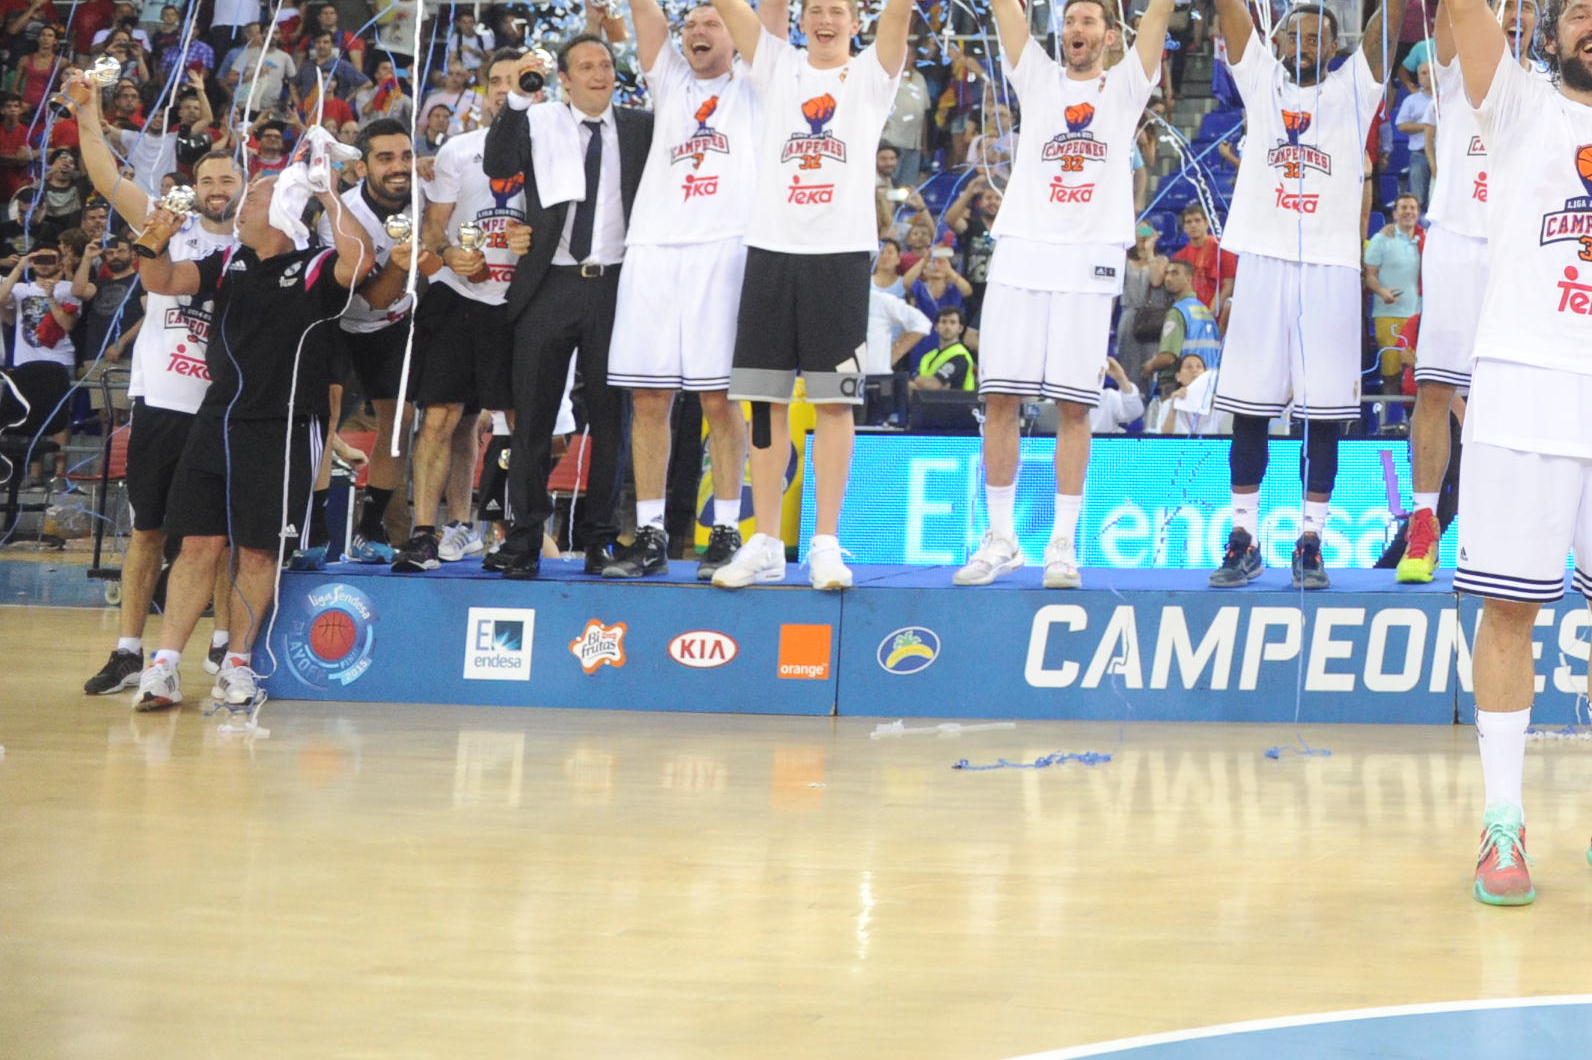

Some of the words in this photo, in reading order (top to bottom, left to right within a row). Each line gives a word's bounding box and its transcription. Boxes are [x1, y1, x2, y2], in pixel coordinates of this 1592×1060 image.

[1061, 155, 1084, 172] 32
[1099, 502, 1394, 568] enesa
[588, 630, 600, 646] Bi
[581, 641, 616, 659] frutas
[679, 639, 726, 659] KIA
[474, 655, 521, 669] endesa
